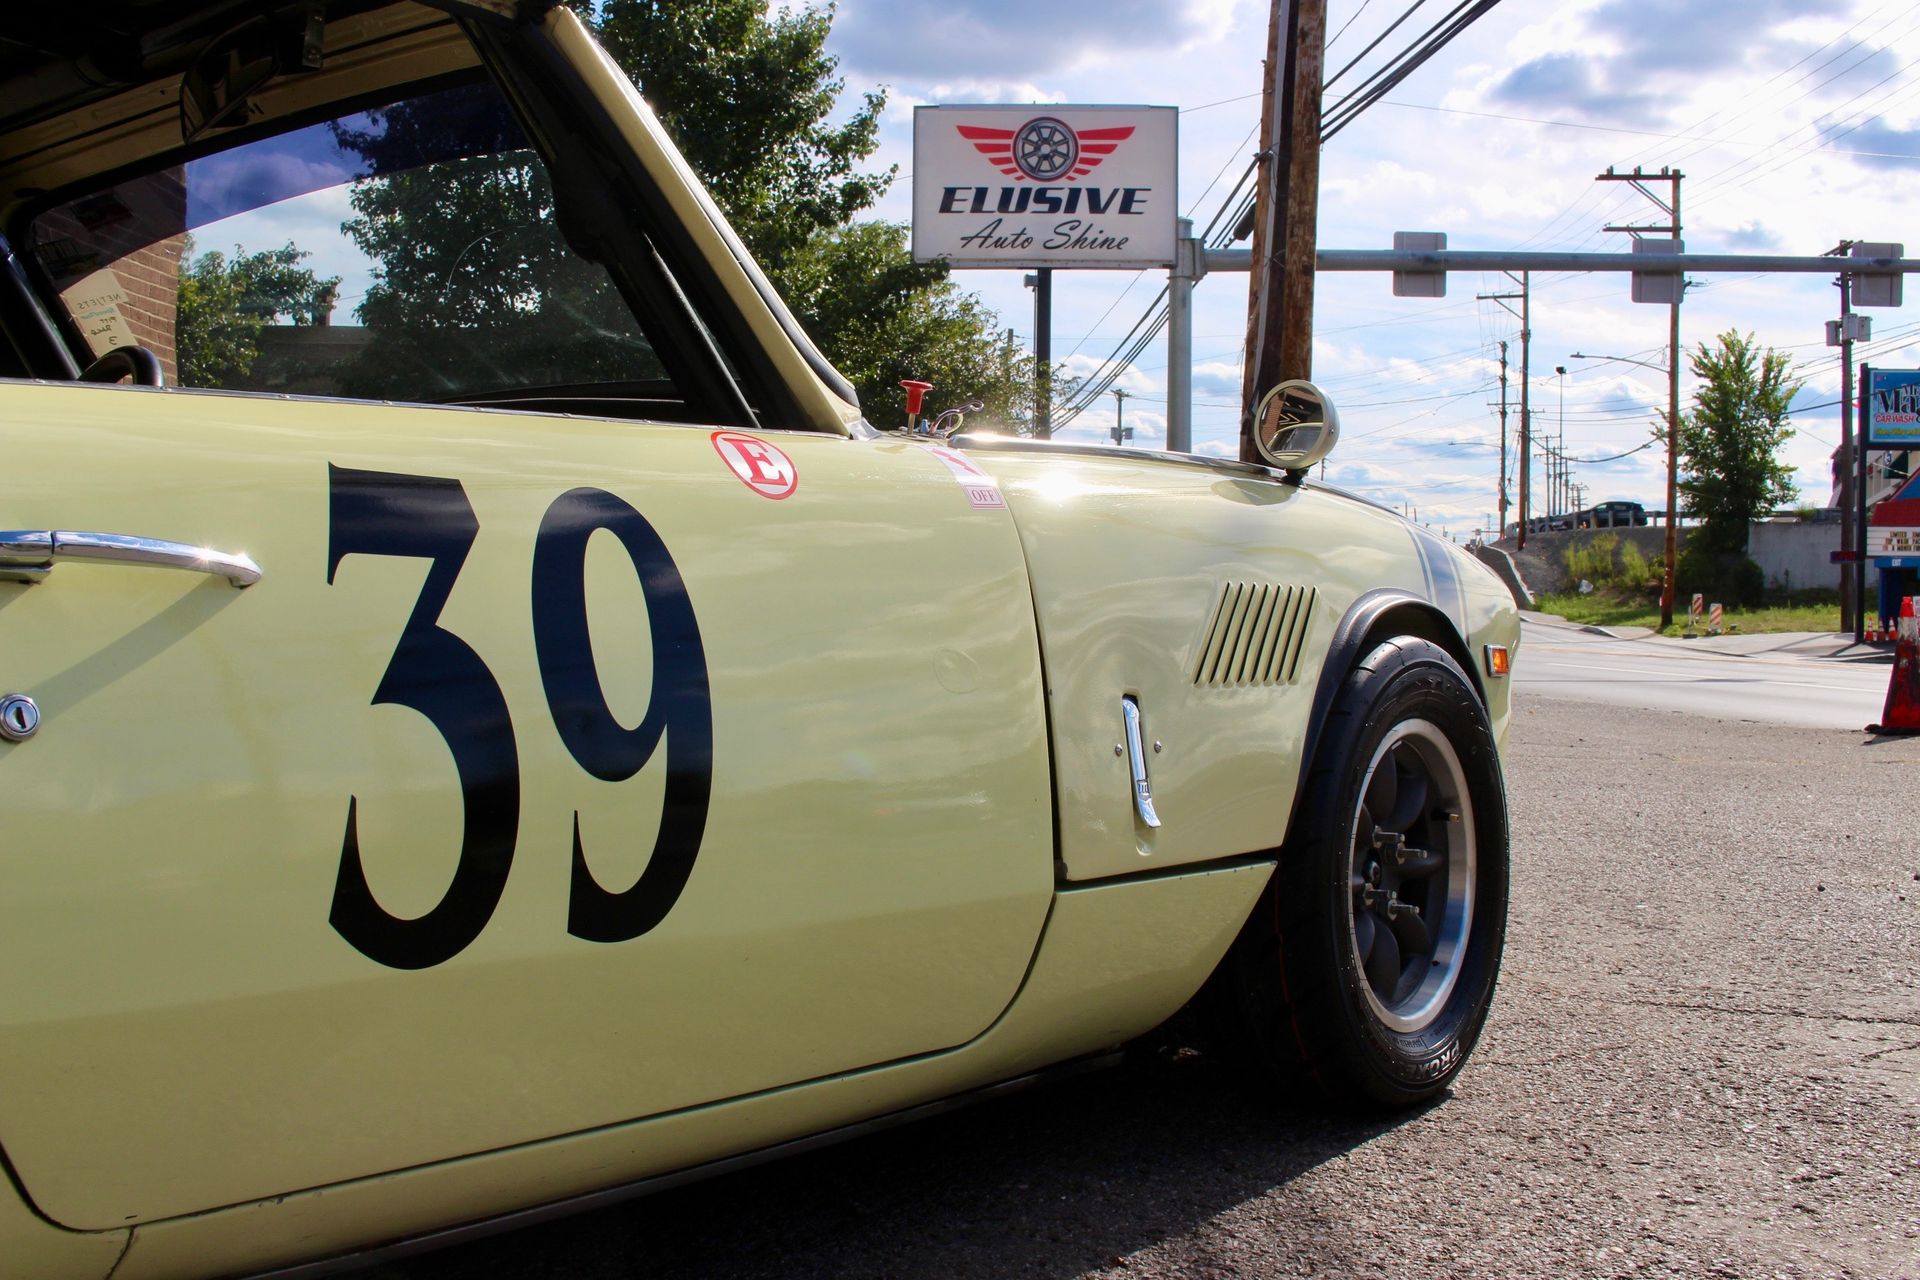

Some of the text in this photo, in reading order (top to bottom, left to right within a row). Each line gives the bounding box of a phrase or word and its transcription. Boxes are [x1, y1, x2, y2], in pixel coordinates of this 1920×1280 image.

[938, 187, 1152, 215] ELUSIVE
[960, 218, 1130, 250] Auto Shine
[1875, 415, 1915, 423] CAR WASH
[721, 437, 789, 487] E
[971, 489, 995, 502] OFF
[327, 461, 713, 971] 39
